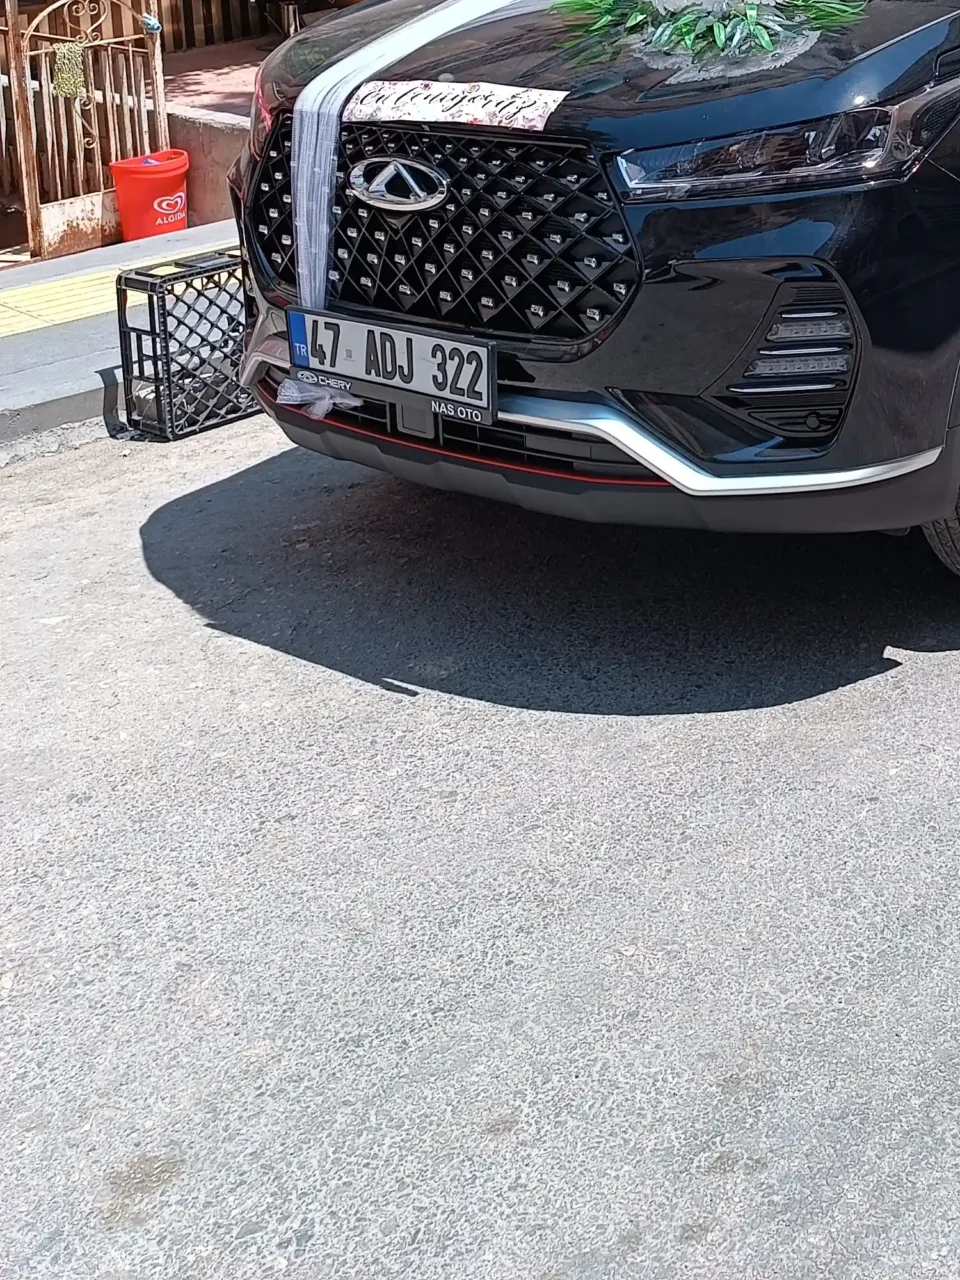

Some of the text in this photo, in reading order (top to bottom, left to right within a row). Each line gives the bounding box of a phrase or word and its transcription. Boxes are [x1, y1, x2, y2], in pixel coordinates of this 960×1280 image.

[294, 342, 308, 358] TR
[310, 319, 484, 402] 47 ADJ 322
[319, 376, 352, 391] CHERY
[431, 400, 482, 423] NAS OTO
